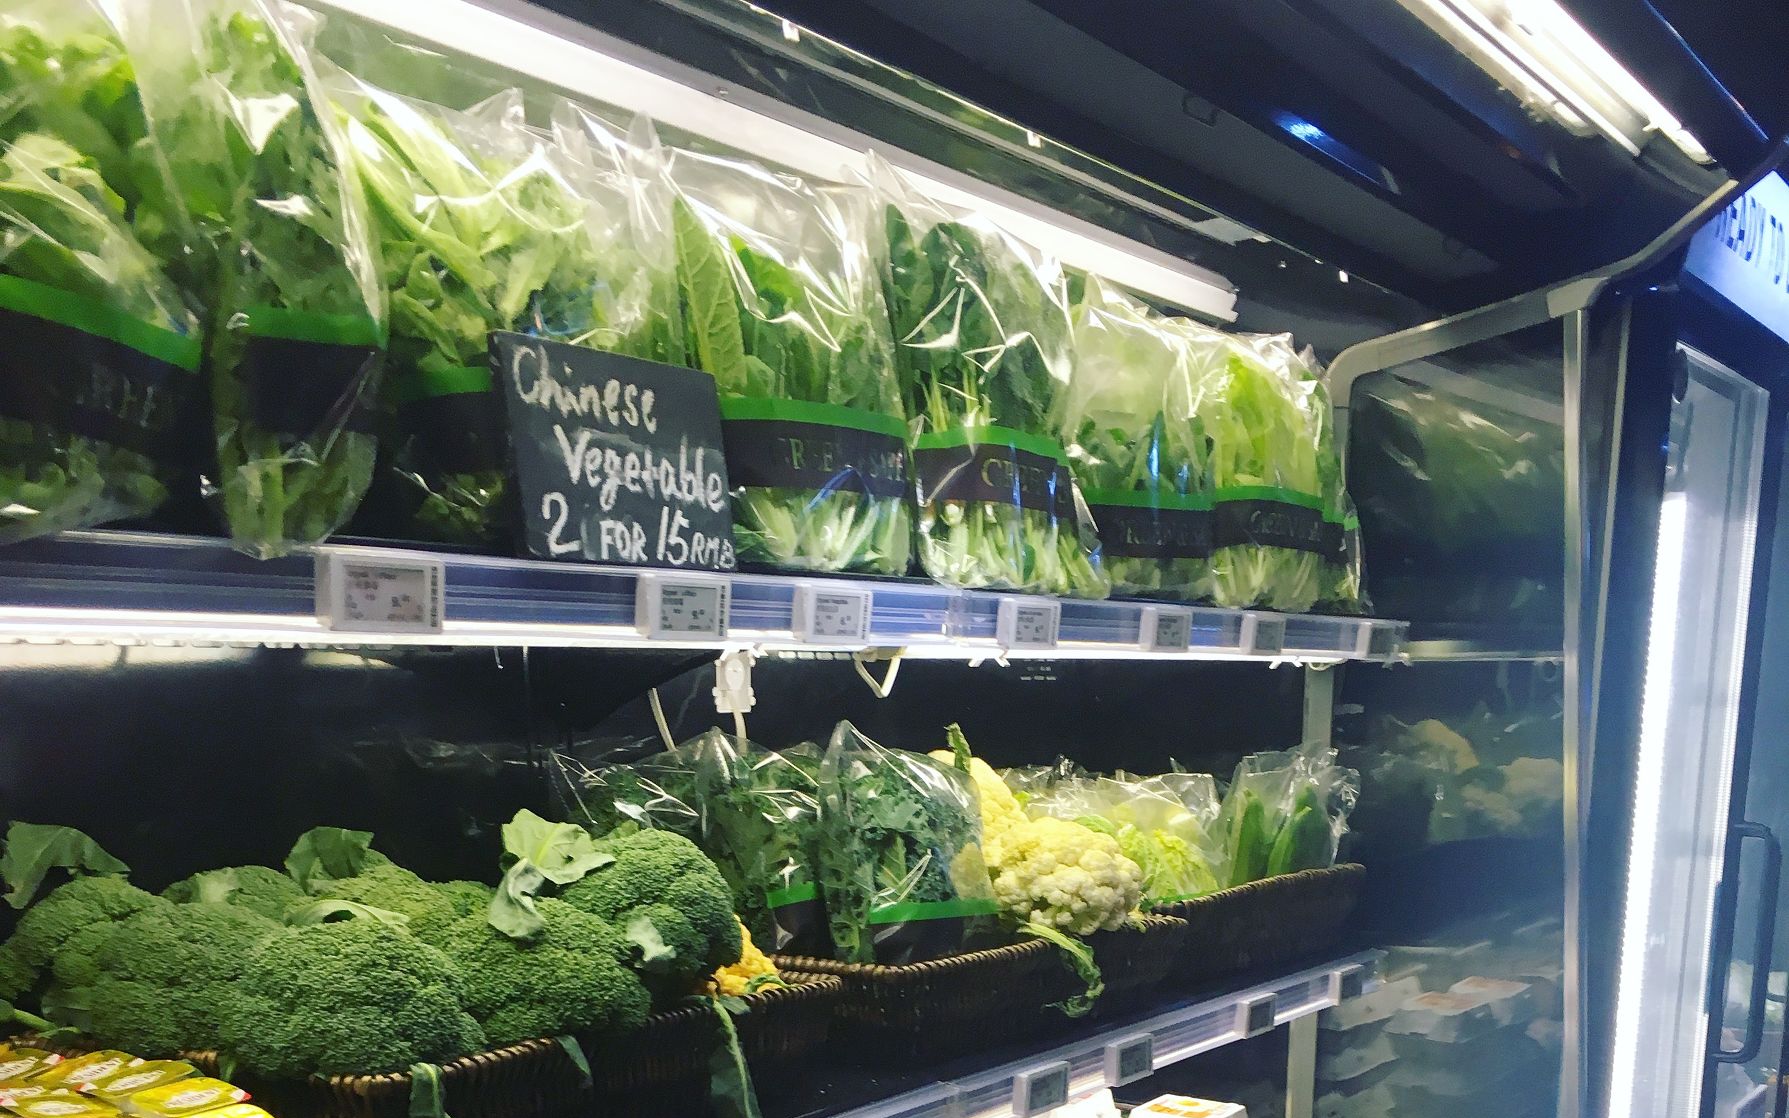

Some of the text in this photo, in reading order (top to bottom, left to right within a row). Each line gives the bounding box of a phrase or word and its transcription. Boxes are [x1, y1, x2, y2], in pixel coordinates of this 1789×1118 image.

[512, 344, 658, 434] Chinese
[552, 424, 727, 513] Vegetable
[541, 491, 581, 557] 2
[599, 518, 648, 562] FOR
